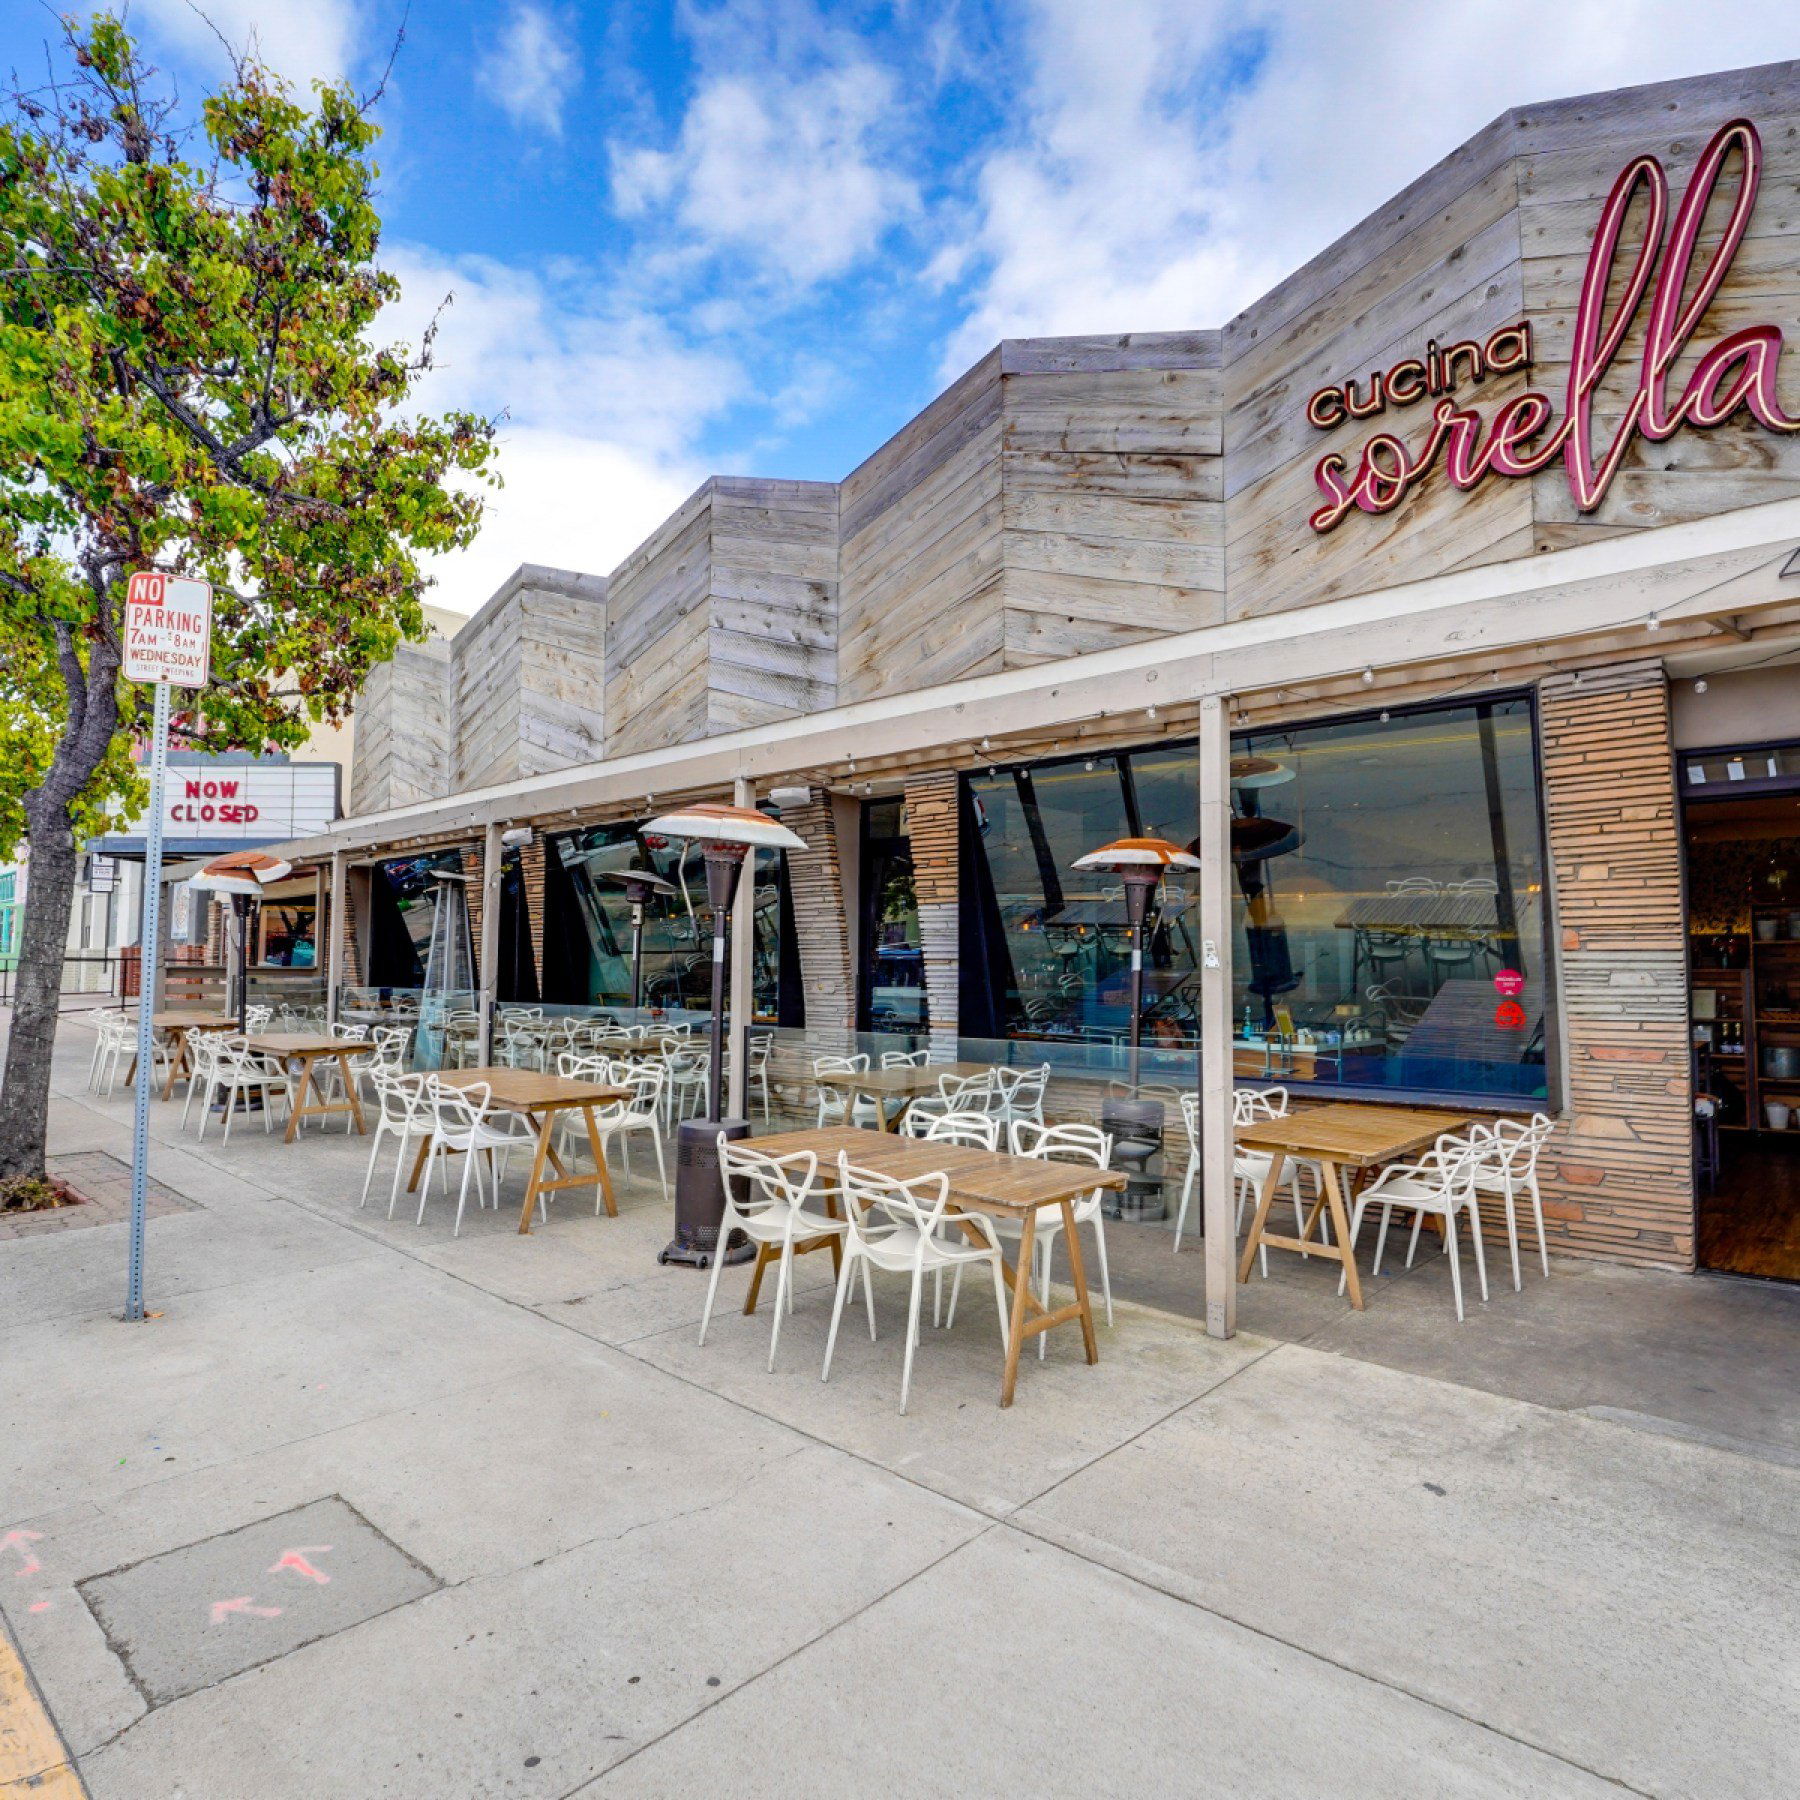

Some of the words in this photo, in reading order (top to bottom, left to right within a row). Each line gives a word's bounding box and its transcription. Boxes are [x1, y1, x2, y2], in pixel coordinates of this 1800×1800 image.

[1309, 118, 1800, 532] sorella
[1307, 320, 1533, 428] cucina
[134, 578, 161, 601] NO
[134, 607, 202, 634] PARKING
[130, 649, 201, 667] WEDNESDAY
[136, 664, 158, 673] STREET
[185, 780, 239, 799] NOW
[170, 804, 259, 823] CLOSED
